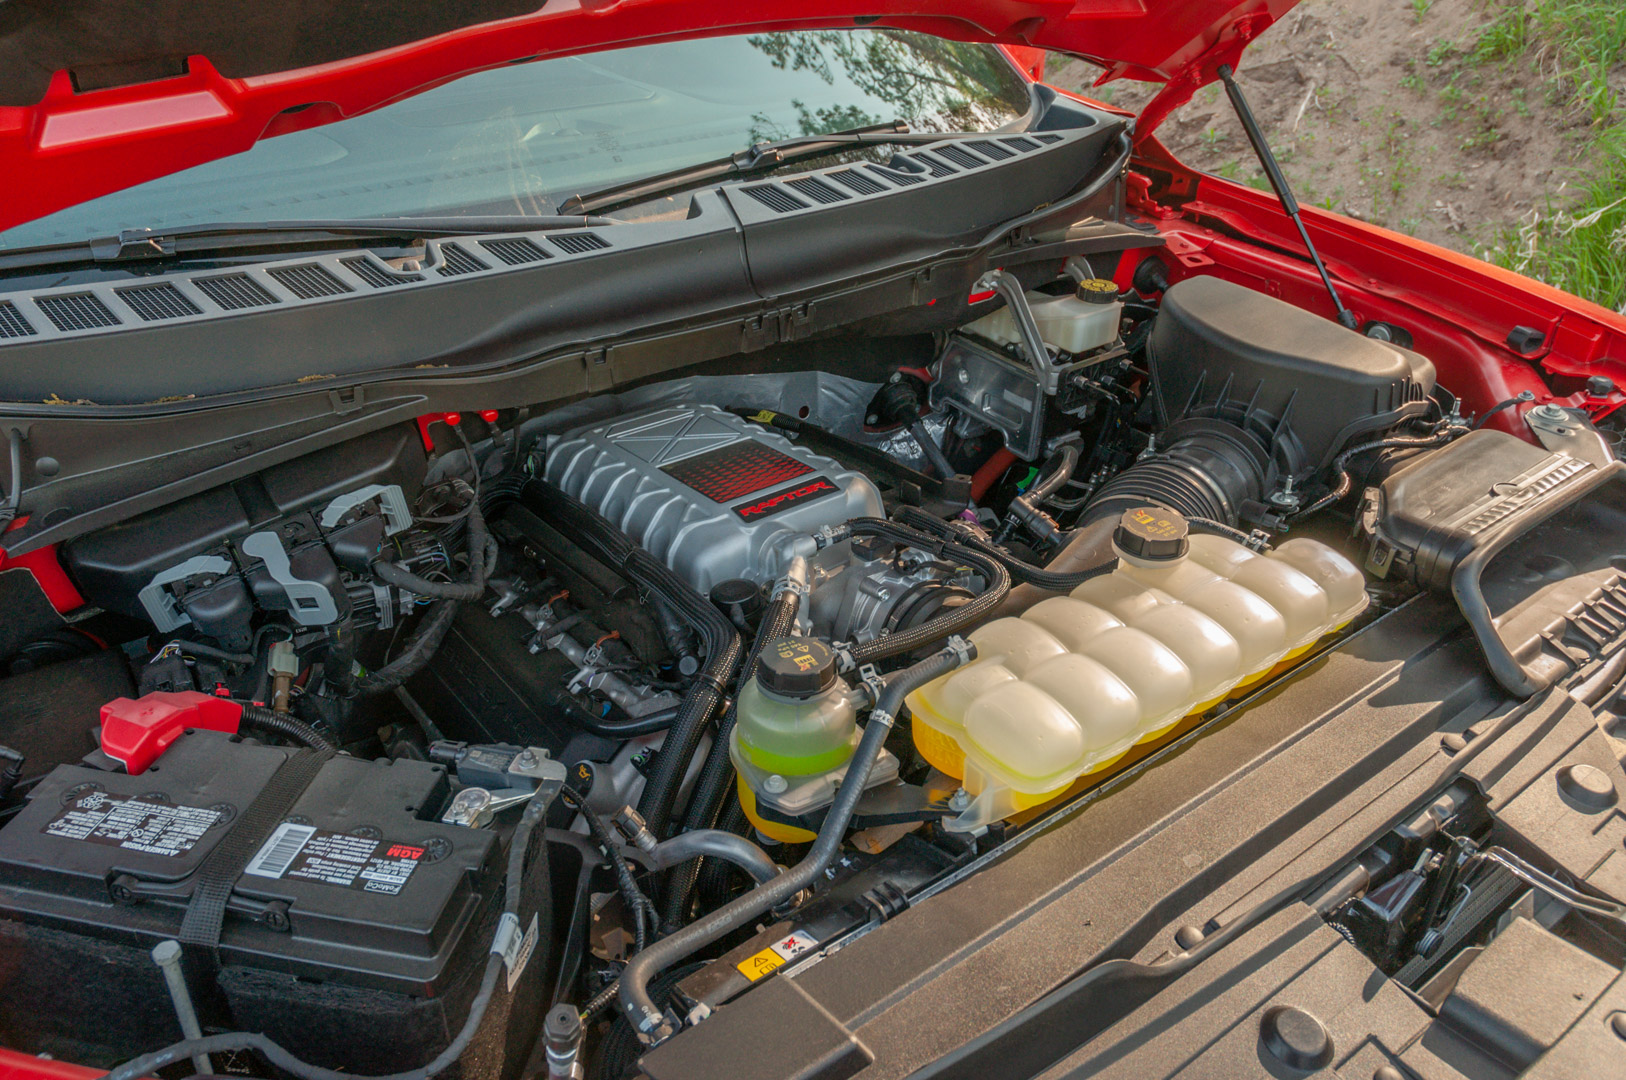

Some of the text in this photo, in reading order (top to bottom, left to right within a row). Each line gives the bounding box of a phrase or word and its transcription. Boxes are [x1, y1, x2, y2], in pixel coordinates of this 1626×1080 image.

[739, 480, 835, 517] RAPTOR
[385, 847, 422, 860] AGM
[364, 881, 400, 892] FoMoCo
